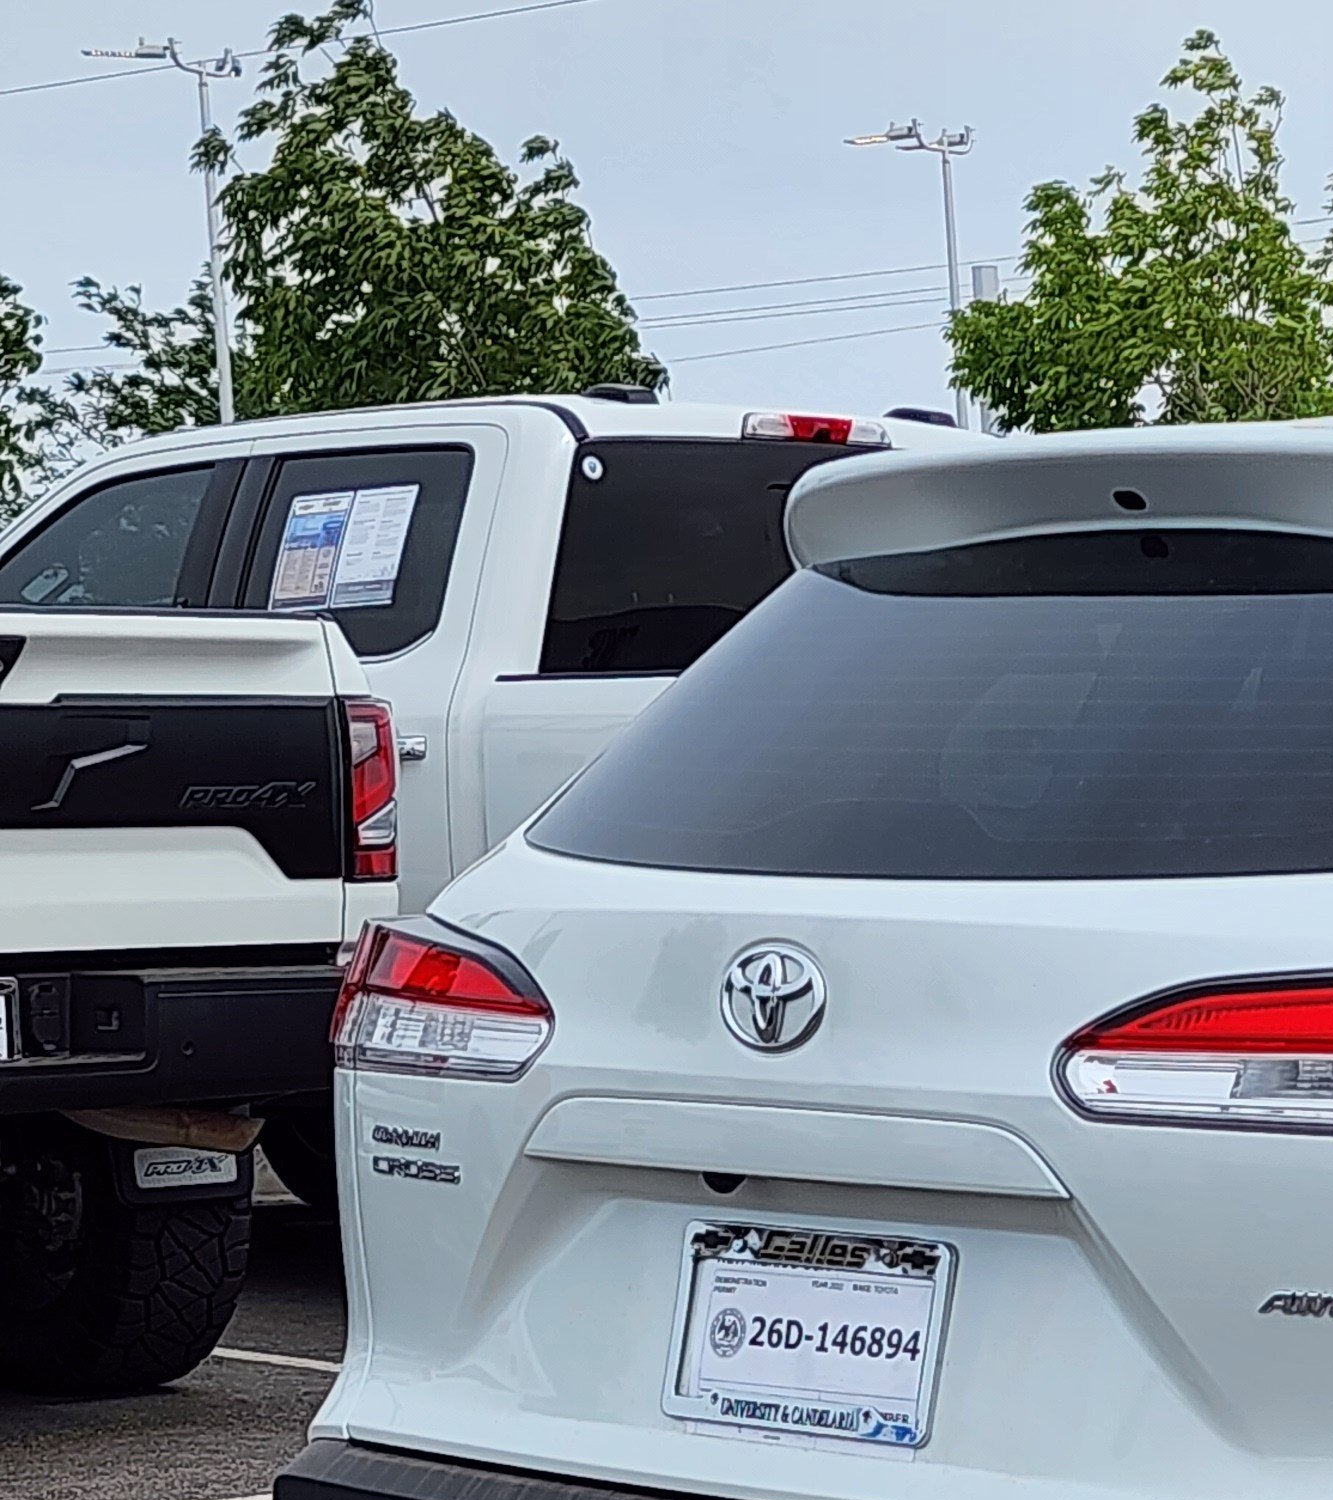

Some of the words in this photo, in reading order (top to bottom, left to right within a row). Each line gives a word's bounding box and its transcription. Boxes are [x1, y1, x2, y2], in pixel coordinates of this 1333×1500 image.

[373, 1156, 461, 1186] CROSS
[748, 1315, 921, 1362] 26D-146894
[719, 1396, 781, 1423] UNIVERSITY
[780, 1404, 790, 1423] &
